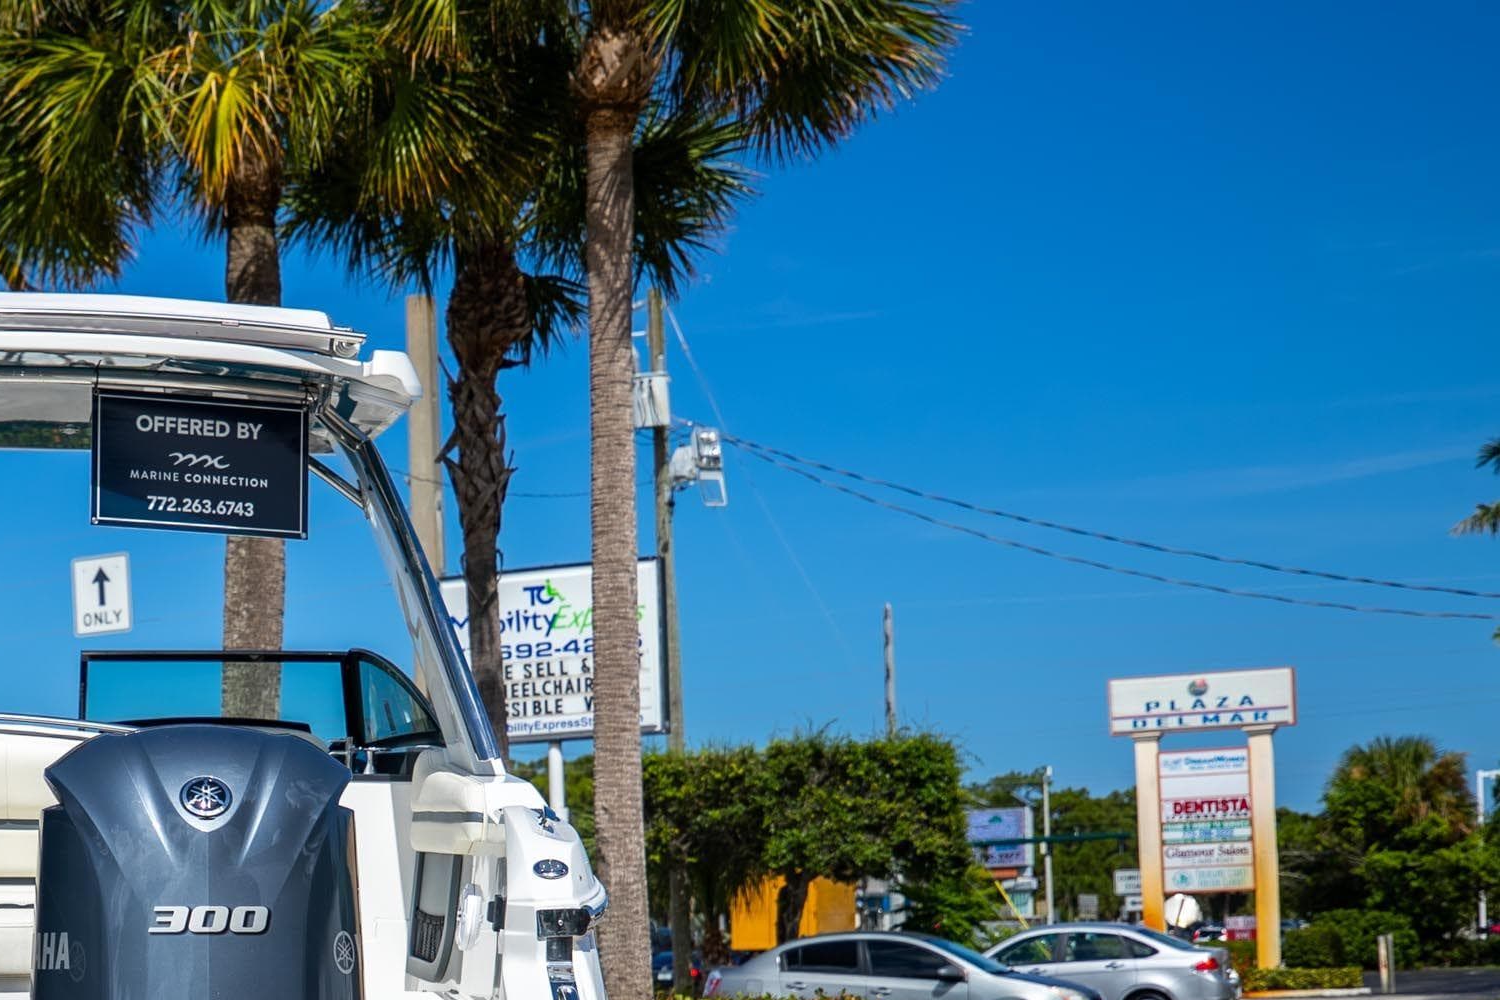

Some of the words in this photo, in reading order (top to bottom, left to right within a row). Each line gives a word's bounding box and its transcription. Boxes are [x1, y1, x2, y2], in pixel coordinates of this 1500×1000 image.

[136, 414, 231, 438] OFFERED
[236, 421, 263, 440] BY
[129, 469, 180, 482] MARINE
[184, 473, 269, 488] CONNECTION
[146, 495, 255, 517] 772.263.6743
[83, 609, 122, 627] ONLY
[523, 660, 568, 678] SELL
[1145, 695, 1254, 713] PLAZA
[1173, 798, 1249, 814] DENTISTA
[147, 905, 269, 933] 300
